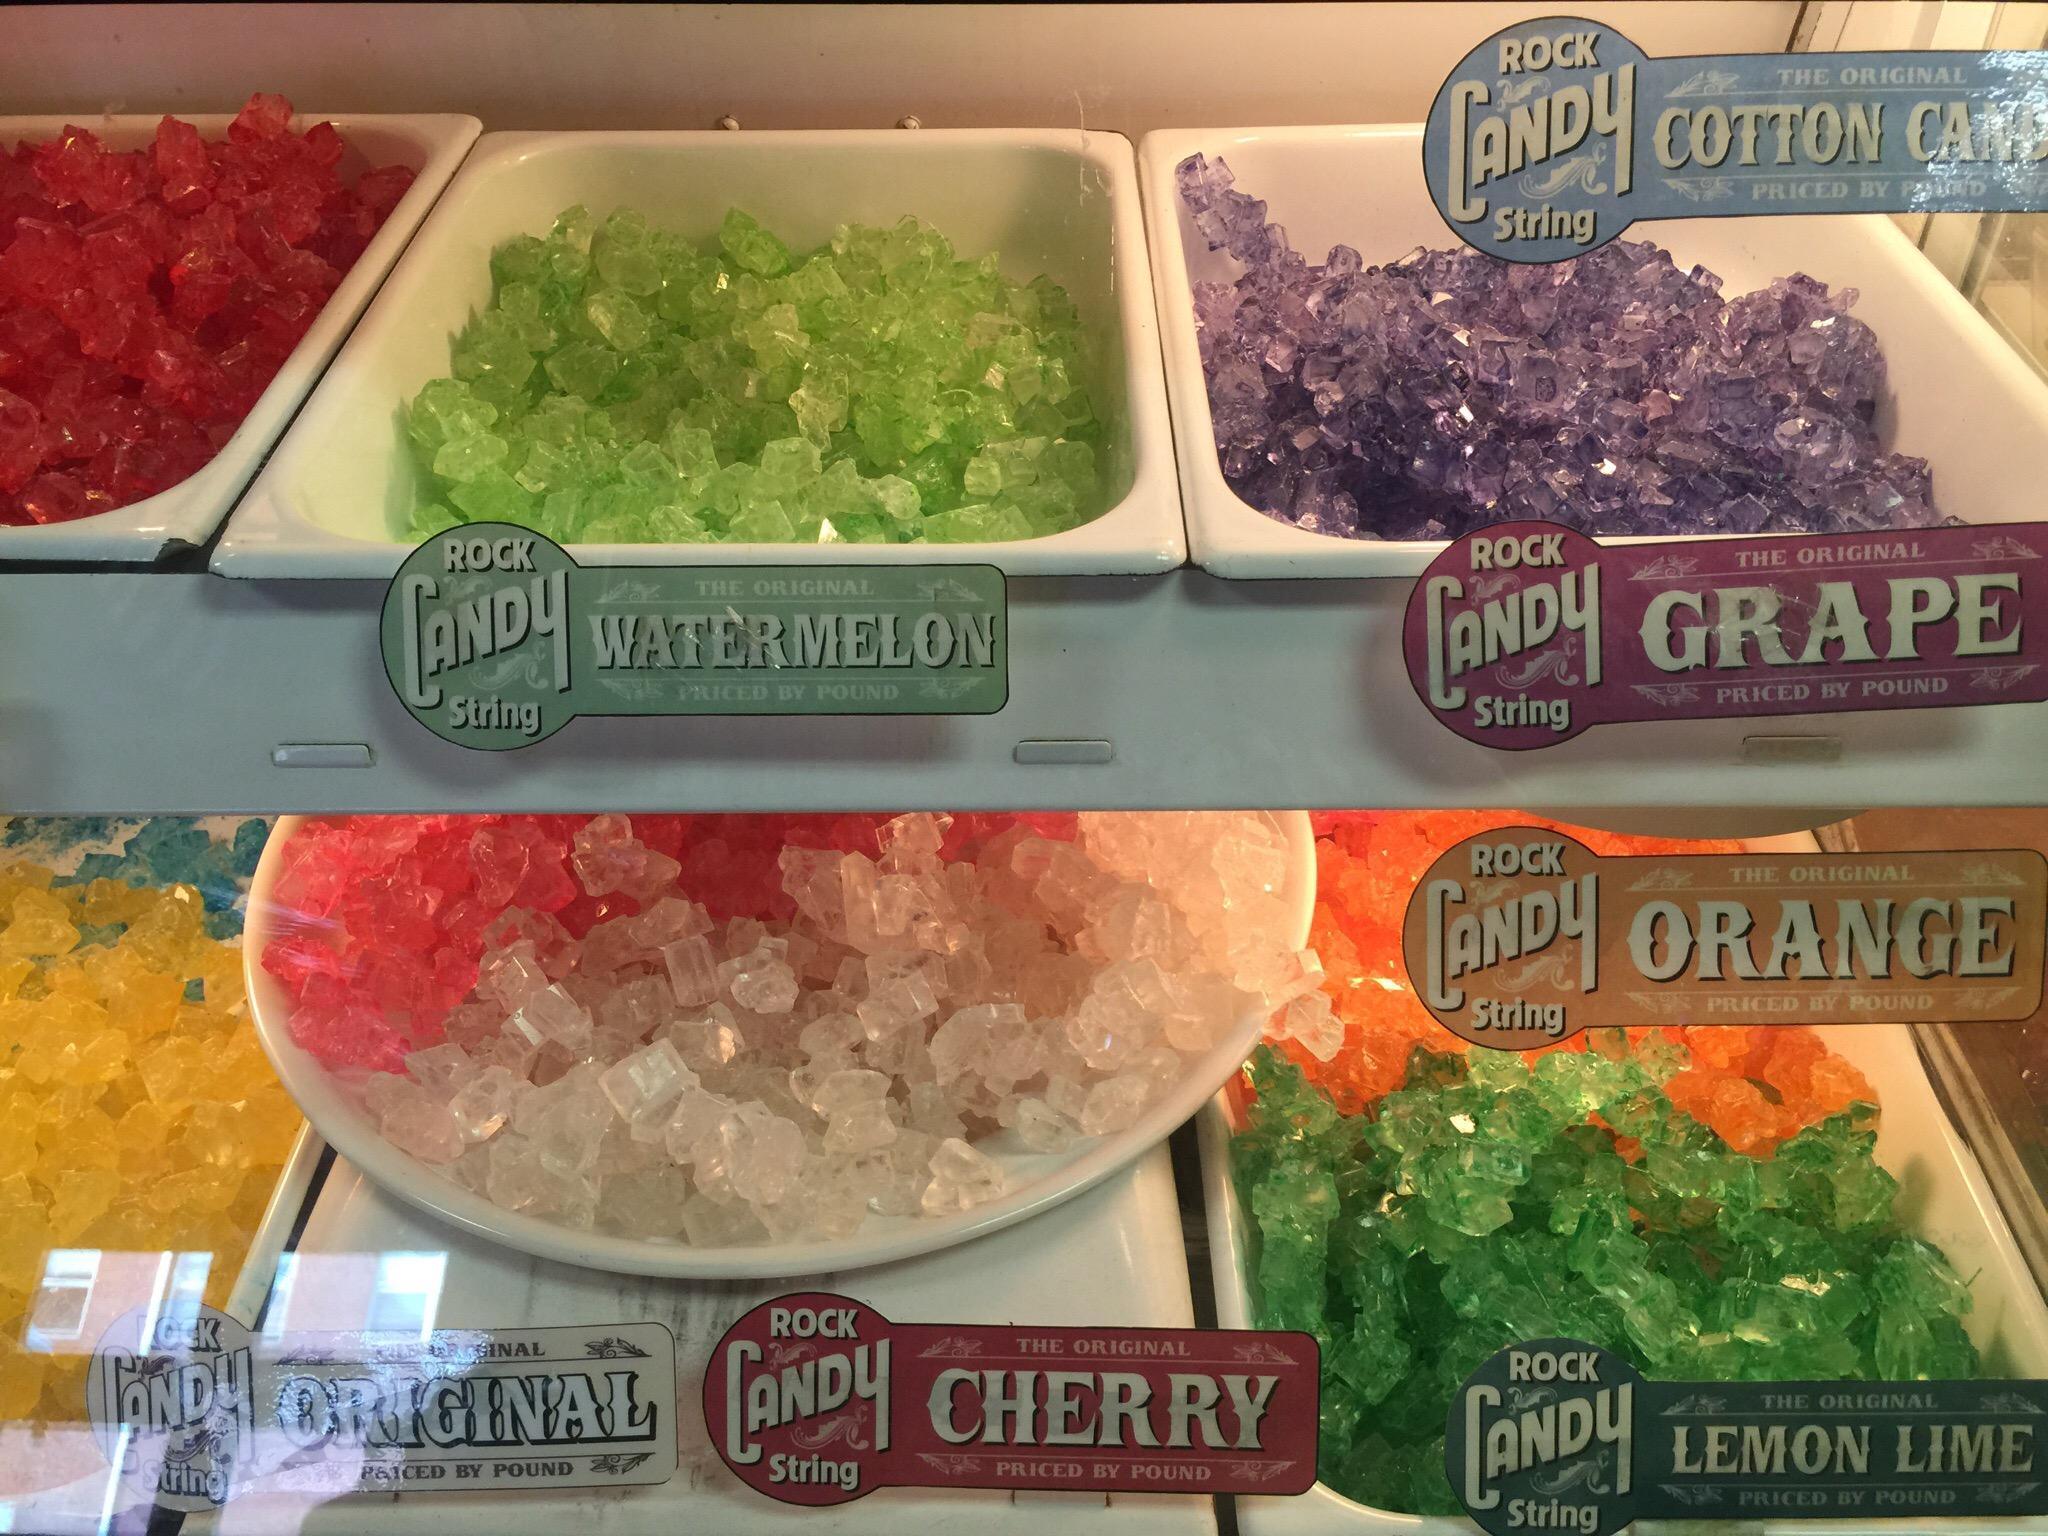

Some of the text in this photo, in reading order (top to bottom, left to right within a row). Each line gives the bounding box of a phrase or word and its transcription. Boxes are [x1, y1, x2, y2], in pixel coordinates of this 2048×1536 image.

[1502, 32, 1598, 73] ROCK
[1778, 67, 1967, 86] THE ORIGINAL
[1449, 62, 1636, 222] CANDY
[1652, 102, 1885, 169] COTTON
[1752, 180, 1987, 200] PRICED BY PUND
[1494, 206, 1595, 244] String
[443, 538, 536, 573] ROCK
[1471, 534, 1566, 569] ROCK
[1736, 542, 1925, 568] THE ORIGINAL
[696, 579, 875, 597] THE ORIGINAL
[402, 569, 572, 710] CANDY
[1426, 562, 1602, 711] CANDY
[1639, 572, 2024, 673] GRAPE
[587, 612, 998, 671] WATERMELON
[679, 685, 899, 700] PRICED BY POUND
[1717, 676, 1949, 704] PRICED BY POUND
[449, 695, 542, 736] String
[1474, 695, 1571, 732] String
[1471, 843, 1566, 877] ROCK
[1729, 865, 1915, 884] THE ORIGINAL
[1426, 873, 1599, 1011] CANDY
[1626, 896, 2017, 982] ORANGE
[1471, 997, 1565, 1036] String
[1707, 993, 1933, 1013] PRICED BY POUND
[770, 1308, 858, 1339] ROCK
[1016, 1339, 1191, 1357] THE ORIGINAL
[1509, 1351, 1600, 1383] ROCK
[278, 1371, 657, 1449] ORIGINAL
[726, 1338, 890, 1464] CANDY
[927, 1368, 1281, 1449] CHERRY
[1760, 1393, 1939, 1410] THE ORIGINAL
[1465, 1383, 1632, 1509] CANDY
[1672, 1424, 2034, 1475] LEMON LIME
[143, 1460, 228, 1504] String
[456, 1463, 482, 1478] BY
[494, 1462, 574, 1478] POUND
[769, 1453, 858, 1492] String
[996, 1461, 1211, 1481] PRICED BY POUND
[1507, 1498, 1598, 1531] String
[1739, 1488, 1956, 1506] PRICED BY POUND
